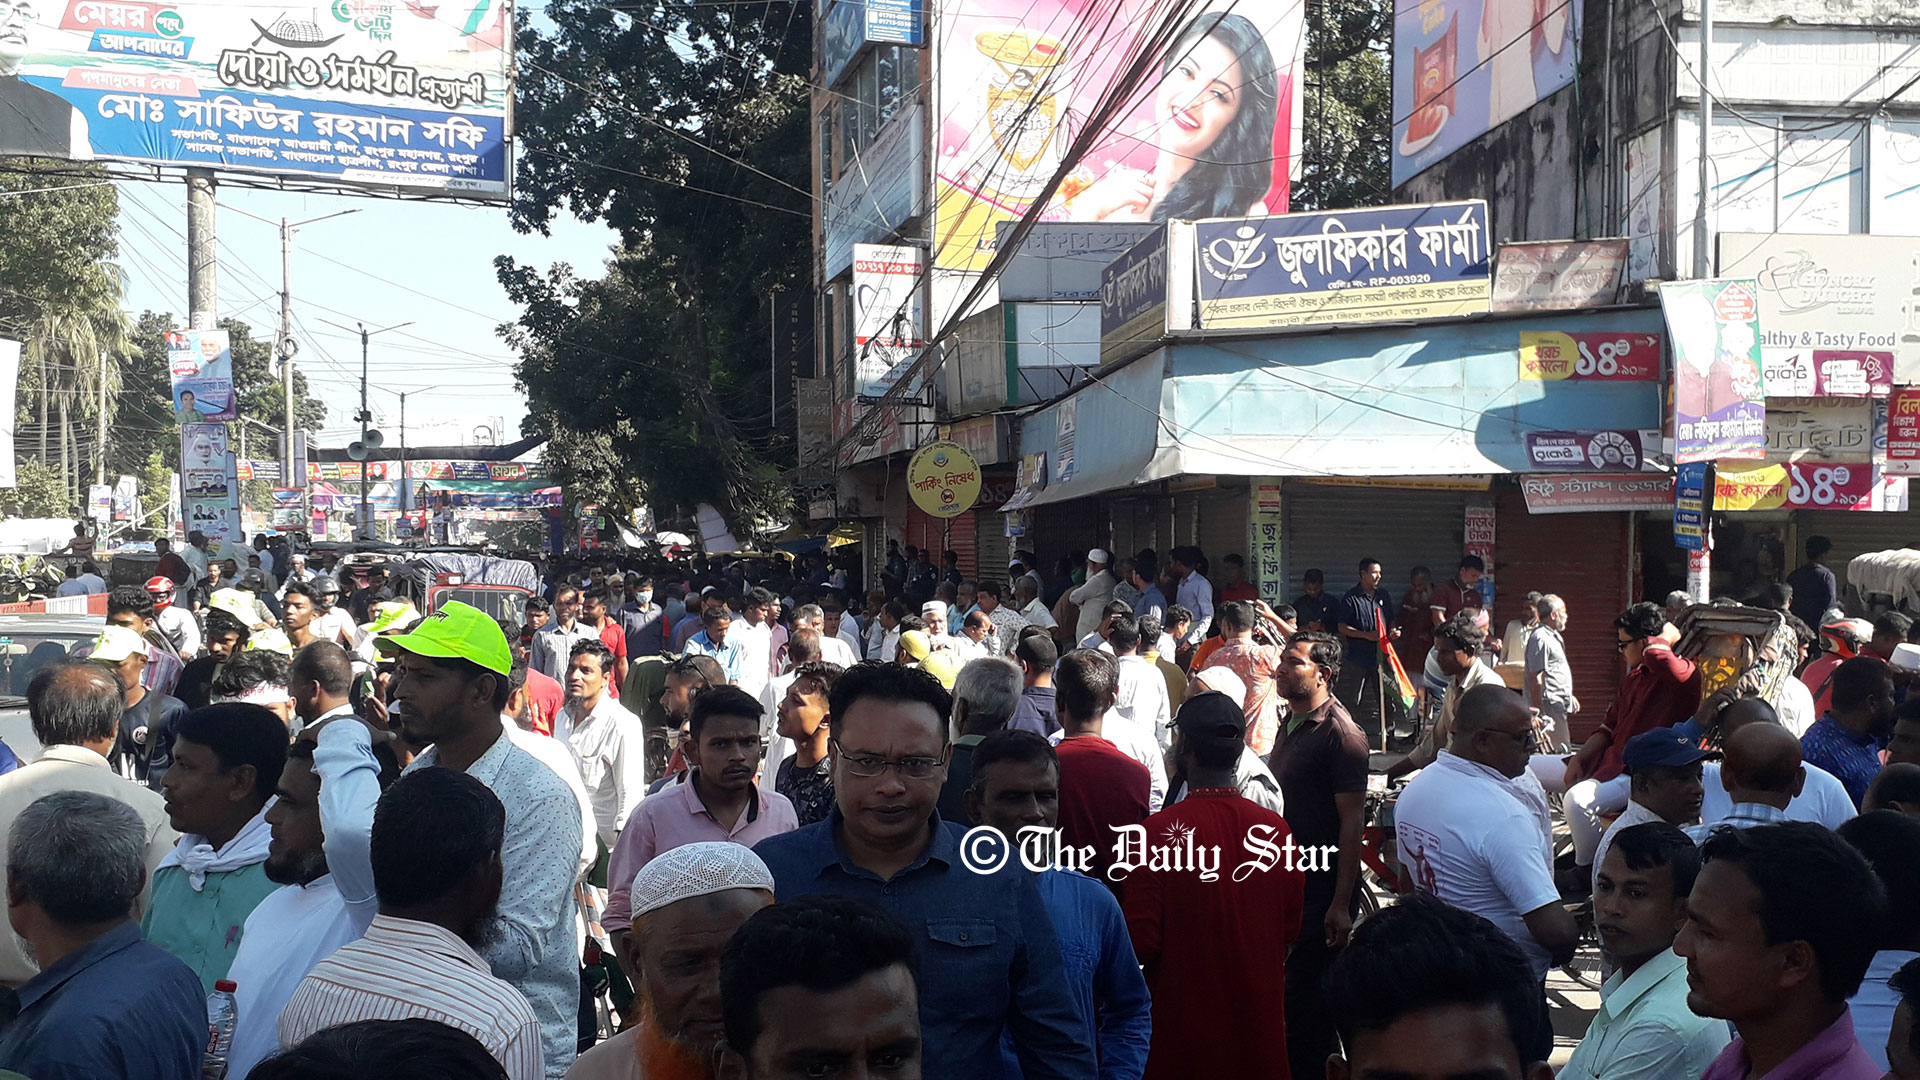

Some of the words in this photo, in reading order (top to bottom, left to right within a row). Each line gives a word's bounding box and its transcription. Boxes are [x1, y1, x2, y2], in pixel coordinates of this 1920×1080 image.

[74, 2, 150, 29] মেয়র
[156, 16, 183, 32] পদে
[99, 33, 185, 57] আপনাদের
[80, 70, 147, 89] গণমানুষের
[150, 77, 182, 91] নেতা
[218, 49, 290, 89] দোয়া
[292, 57, 323, 87] ও
[324, 50, 416, 96] সমর্থন
[419, 73, 485, 109] প্রত্যাশী
[98, 94, 165, 123] মোঃ
[174, 95, 303, 134] সাফিউর
[310, 111, 415, 145] রহমান
[420, 116, 487, 150] সফি
[171, 129, 223, 143] সভাপতি,
[226, 133, 280, 148] বাংলাদেশ
[282, 139, 332, 152] আওয়ামী
[334, 141, 361, 156] লীগ,
[363, 146, 395, 159] রংপুর
[397, 148, 446, 163] মহানগর,
[185, 142, 224, 154] সাবেক
[227, 146, 278, 161] সভাপতি,
[280, 151, 335, 164] বাংলাদেশ
[337, 155, 384, 170] ছাত্রলীগ,
[387, 160, 419, 173] রংপুর
[421, 163, 450, 174] জেলা
[1272, 217, 1409, 289] জুলফিকার
[1413, 206, 1480, 267] ফার্মা
[1369, 274, 1431, 287] RP-003920
[1229, 302, 1251, 313] প্রকার
[1760, 331, 1797, 348] althy
[1801, 332, 1812, 346] &
[1815, 331, 1854, 349] Tasty
[1859, 332, 1896, 346] Food
[1535, 346, 1562, 360] খরচ
[1526, 360, 1569, 374] কমলো
[915, 475, 944, 492] পার্কিং
[945, 471, 975, 487] নিষেধ
[1741, 483, 1784, 499] কমলো
